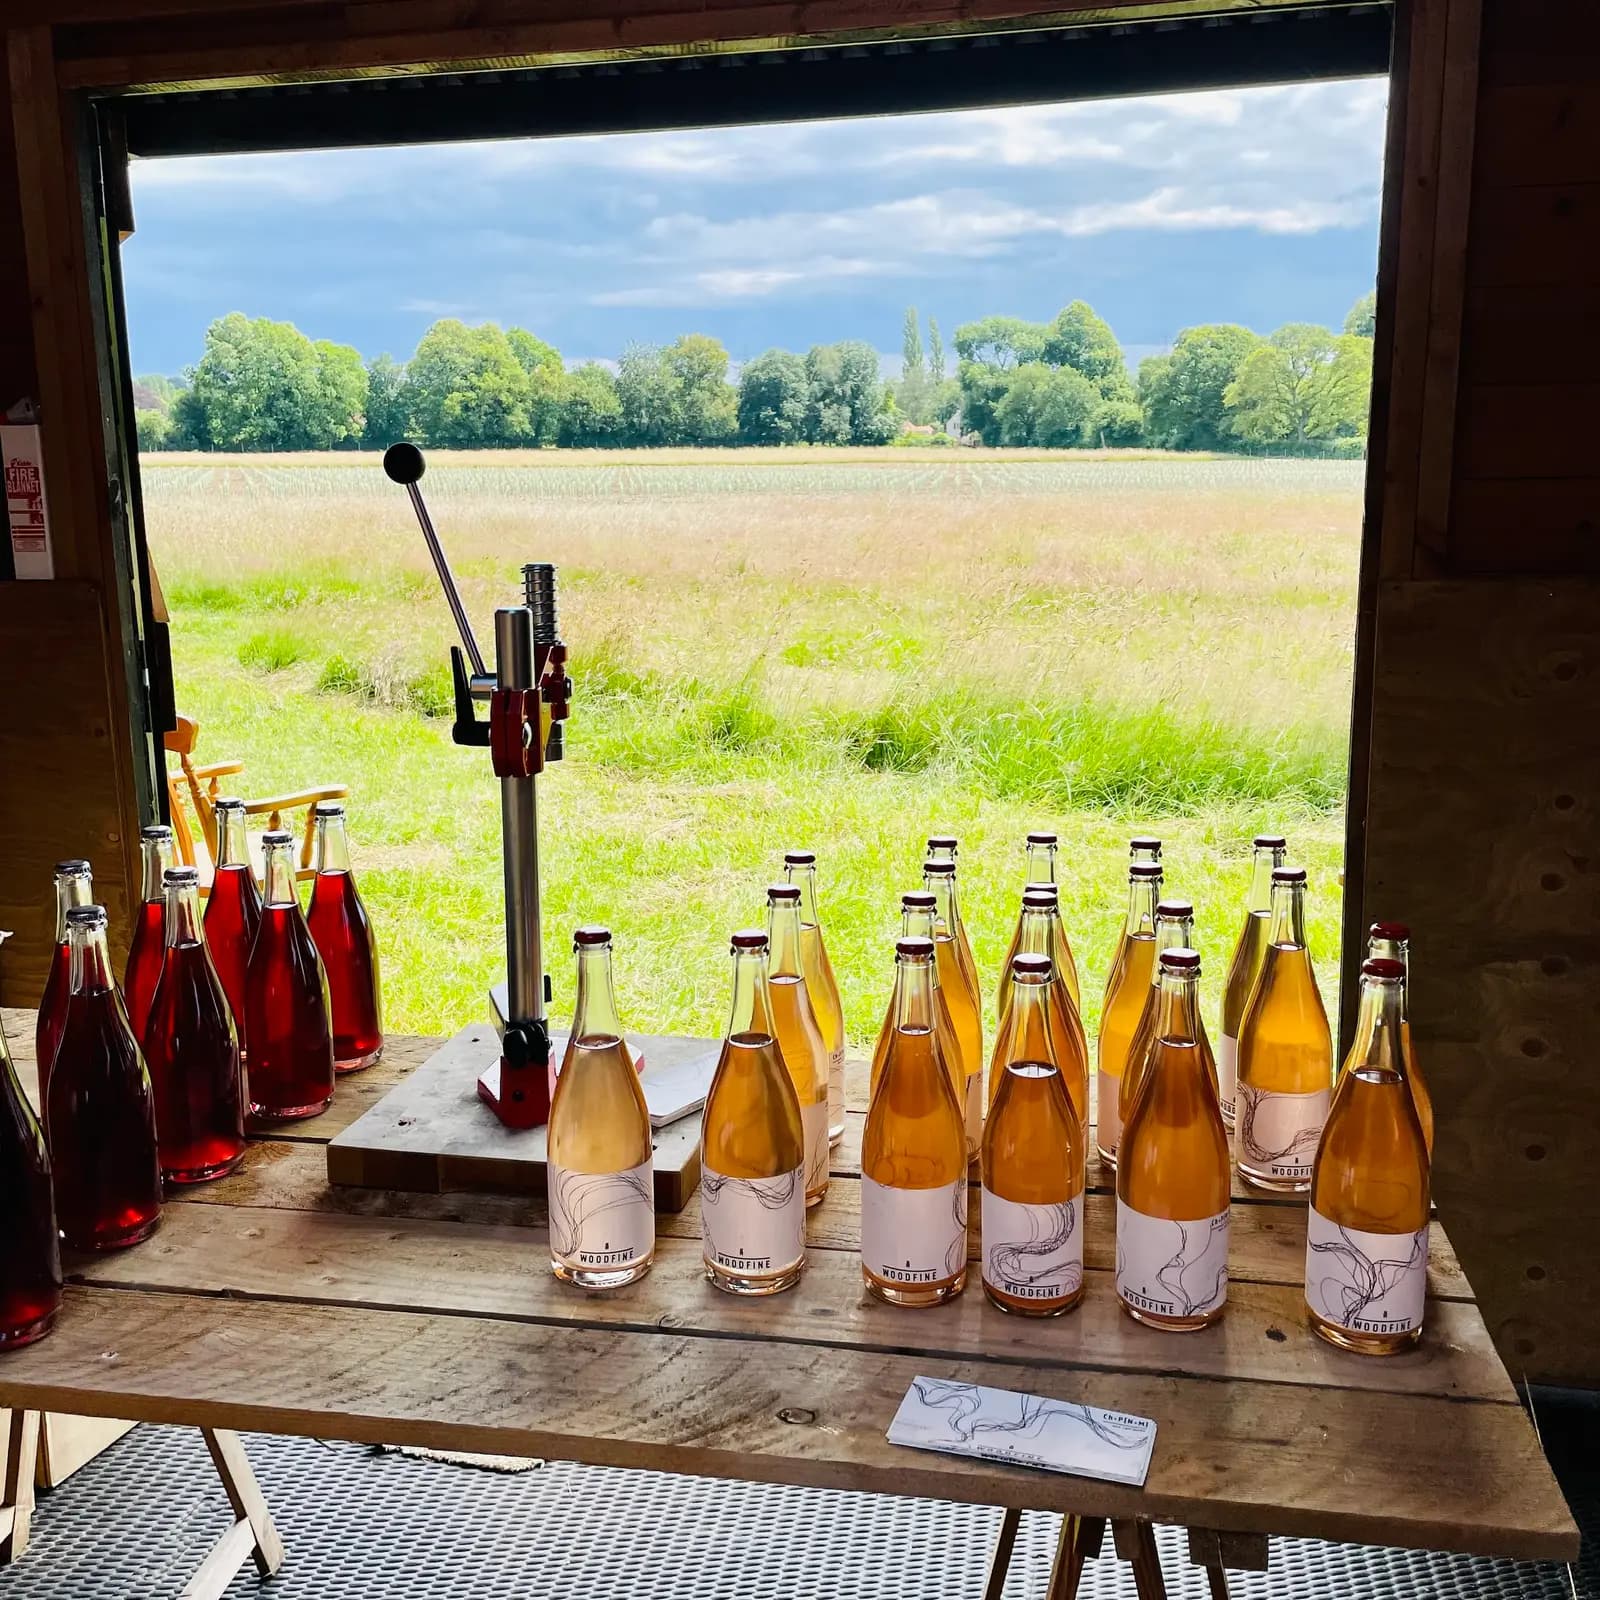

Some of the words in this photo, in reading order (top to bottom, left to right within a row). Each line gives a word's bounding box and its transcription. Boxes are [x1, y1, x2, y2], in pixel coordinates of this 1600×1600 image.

[9, 468, 36, 481] FIRE
[7, 480, 40, 493] BLANKET
[580, 1251, 634, 1264] WOODFINE
[718, 1255, 771, 1270] WOODFINE
[882, 1268, 937, 1282] WOODFINE
[1004, 1283, 1061, 1298] WOODFINE
[1123, 1289, 1174, 1314] WOODFINE
[1353, 1319, 1411, 1333] WOODFINE
